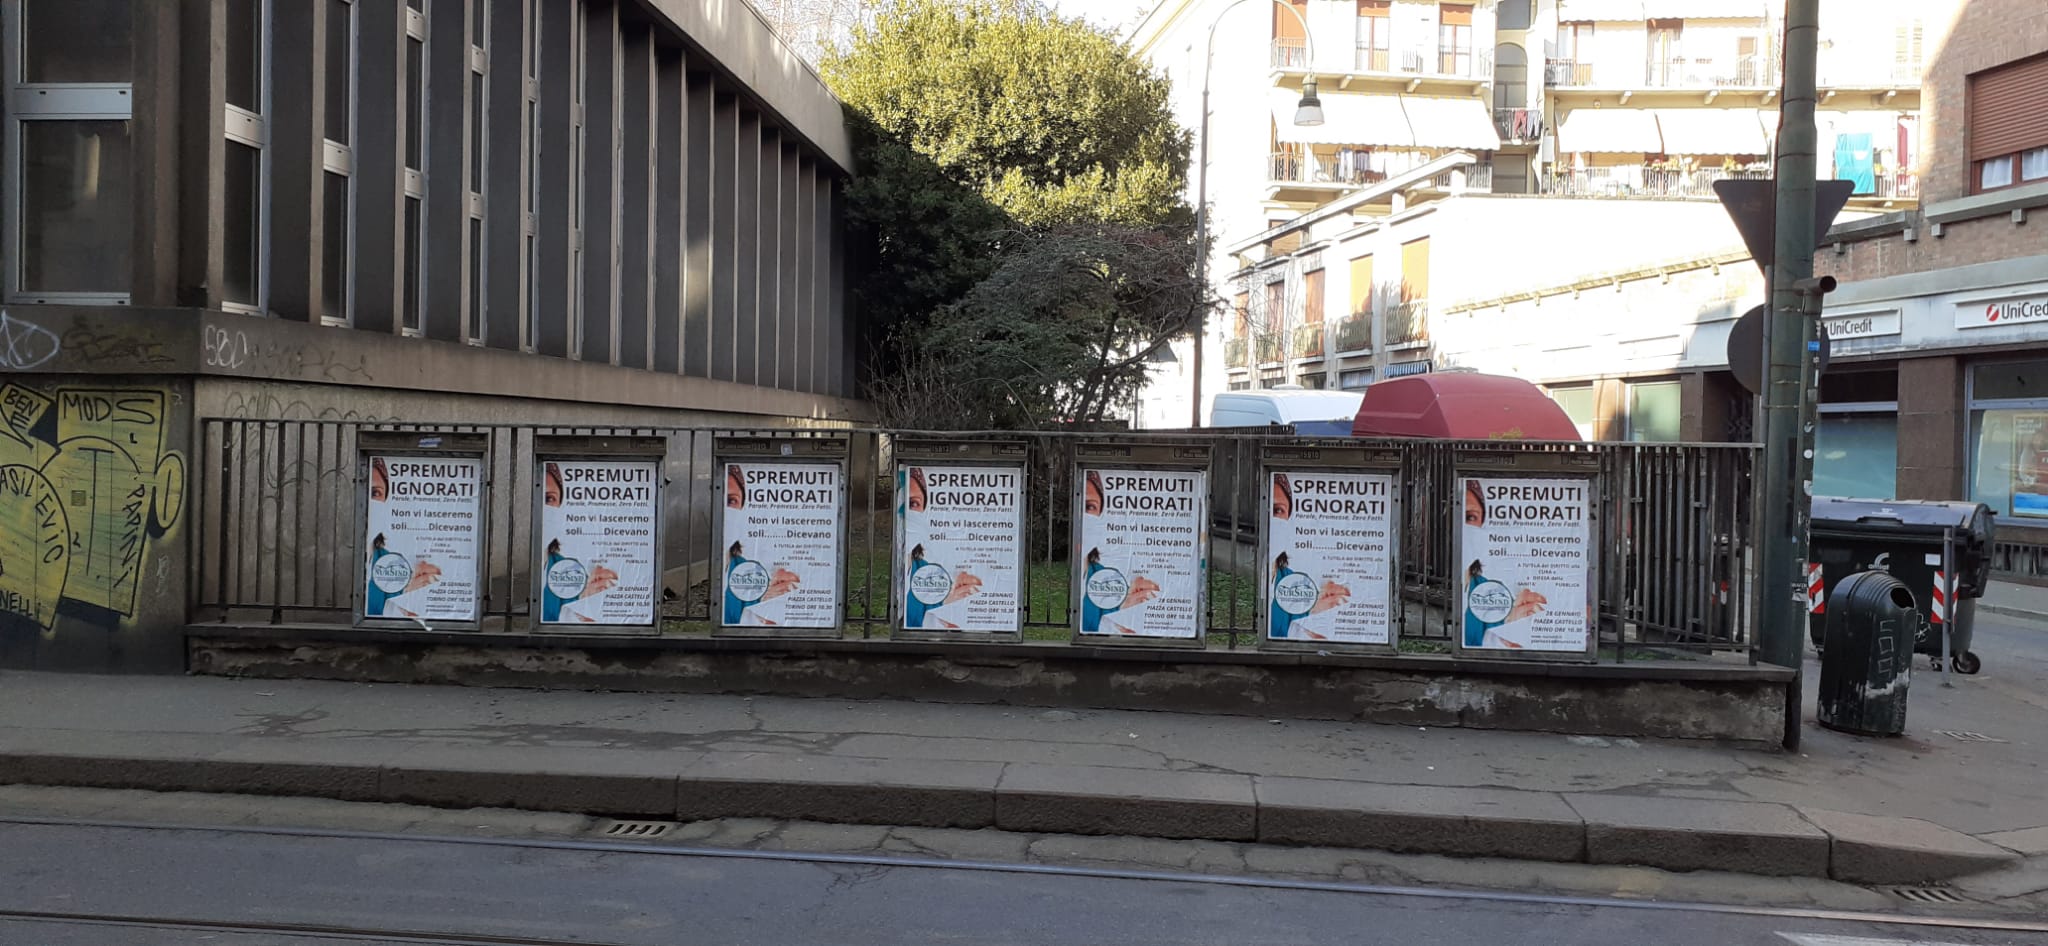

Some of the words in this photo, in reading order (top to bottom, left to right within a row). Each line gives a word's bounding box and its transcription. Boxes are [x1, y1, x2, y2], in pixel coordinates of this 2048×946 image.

[1830, 318, 1872, 335] UniCredit
[390, 463, 473, 478] SPREMUTI
[564, 468, 648, 482] SPREMUTI
[746, 470, 831, 484] SPREMUTI
[928, 473, 1013, 487] SPREMUTI
[1105, 476, 1192, 492] SPREMUTI
[1293, 479, 1384, 495] SPREMUTI
[391, 481, 472, 496] IGNORATI
[566, 487, 648, 500] IGNORATI
[748, 489, 831, 502] IGNORATI
[1486, 486, 1580, 501] SPREMUTI
[930, 491, 1013, 505] IGNORATI
[1107, 495, 1192, 510] IGNORATI
[391, 508, 410, 516] Non
[424, 509, 472, 518] lasceremo
[1295, 498, 1384, 514] IGNORATI
[1489, 505, 1580, 520] IGNORATI
[599, 514, 648, 522] lasceremo
[770, 516, 778, 524] vi
[782, 516, 831, 525] lasceremo
[952, 519, 960, 527] vi
[963, 519, 1013, 527] lasceremo
[1129, 523, 1137, 531] vi
[1141, 523, 1192, 533] lasceremo
[1295, 526, 1316, 535] Non
[1319, 527, 1327, 535] vi
[1331, 527, 1384, 537] lasceremo
[1489, 534, 1510, 542] Non
[1513, 534, 1522, 542] vi
[1526, 534, 1580, 543] lasceremo
